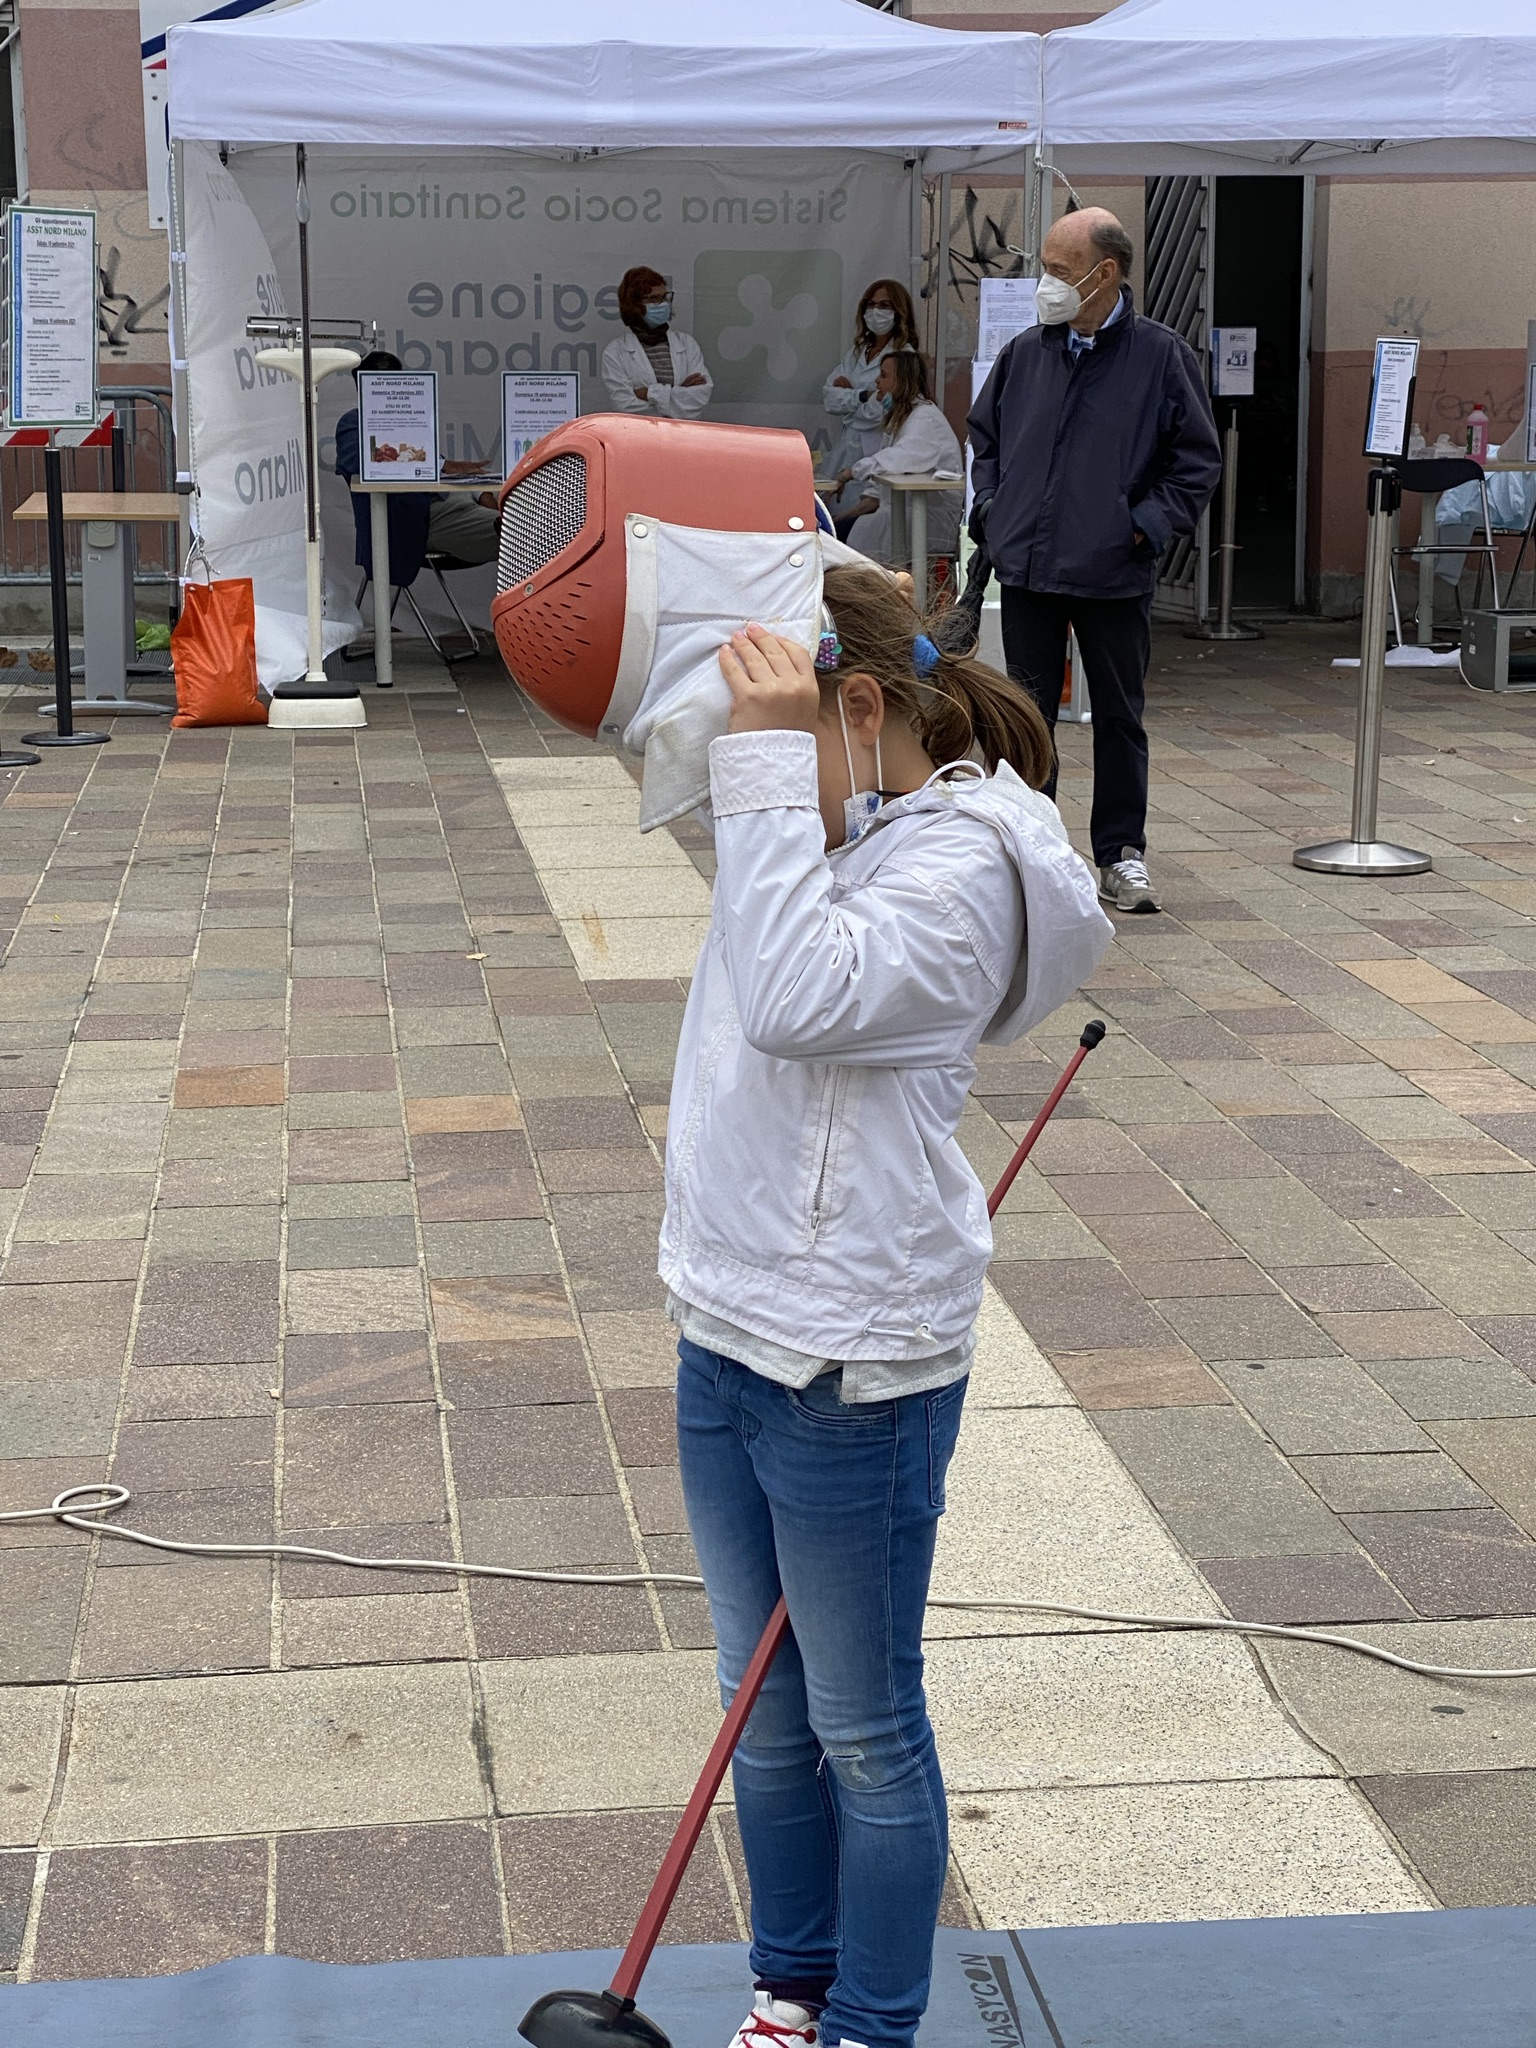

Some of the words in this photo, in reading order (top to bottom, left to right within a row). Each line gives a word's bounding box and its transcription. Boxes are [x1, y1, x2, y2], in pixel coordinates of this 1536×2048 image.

[26, 225, 43, 234] ASST
[44, 226, 62, 235] NORD
[63, 227, 87, 236] MILANO
